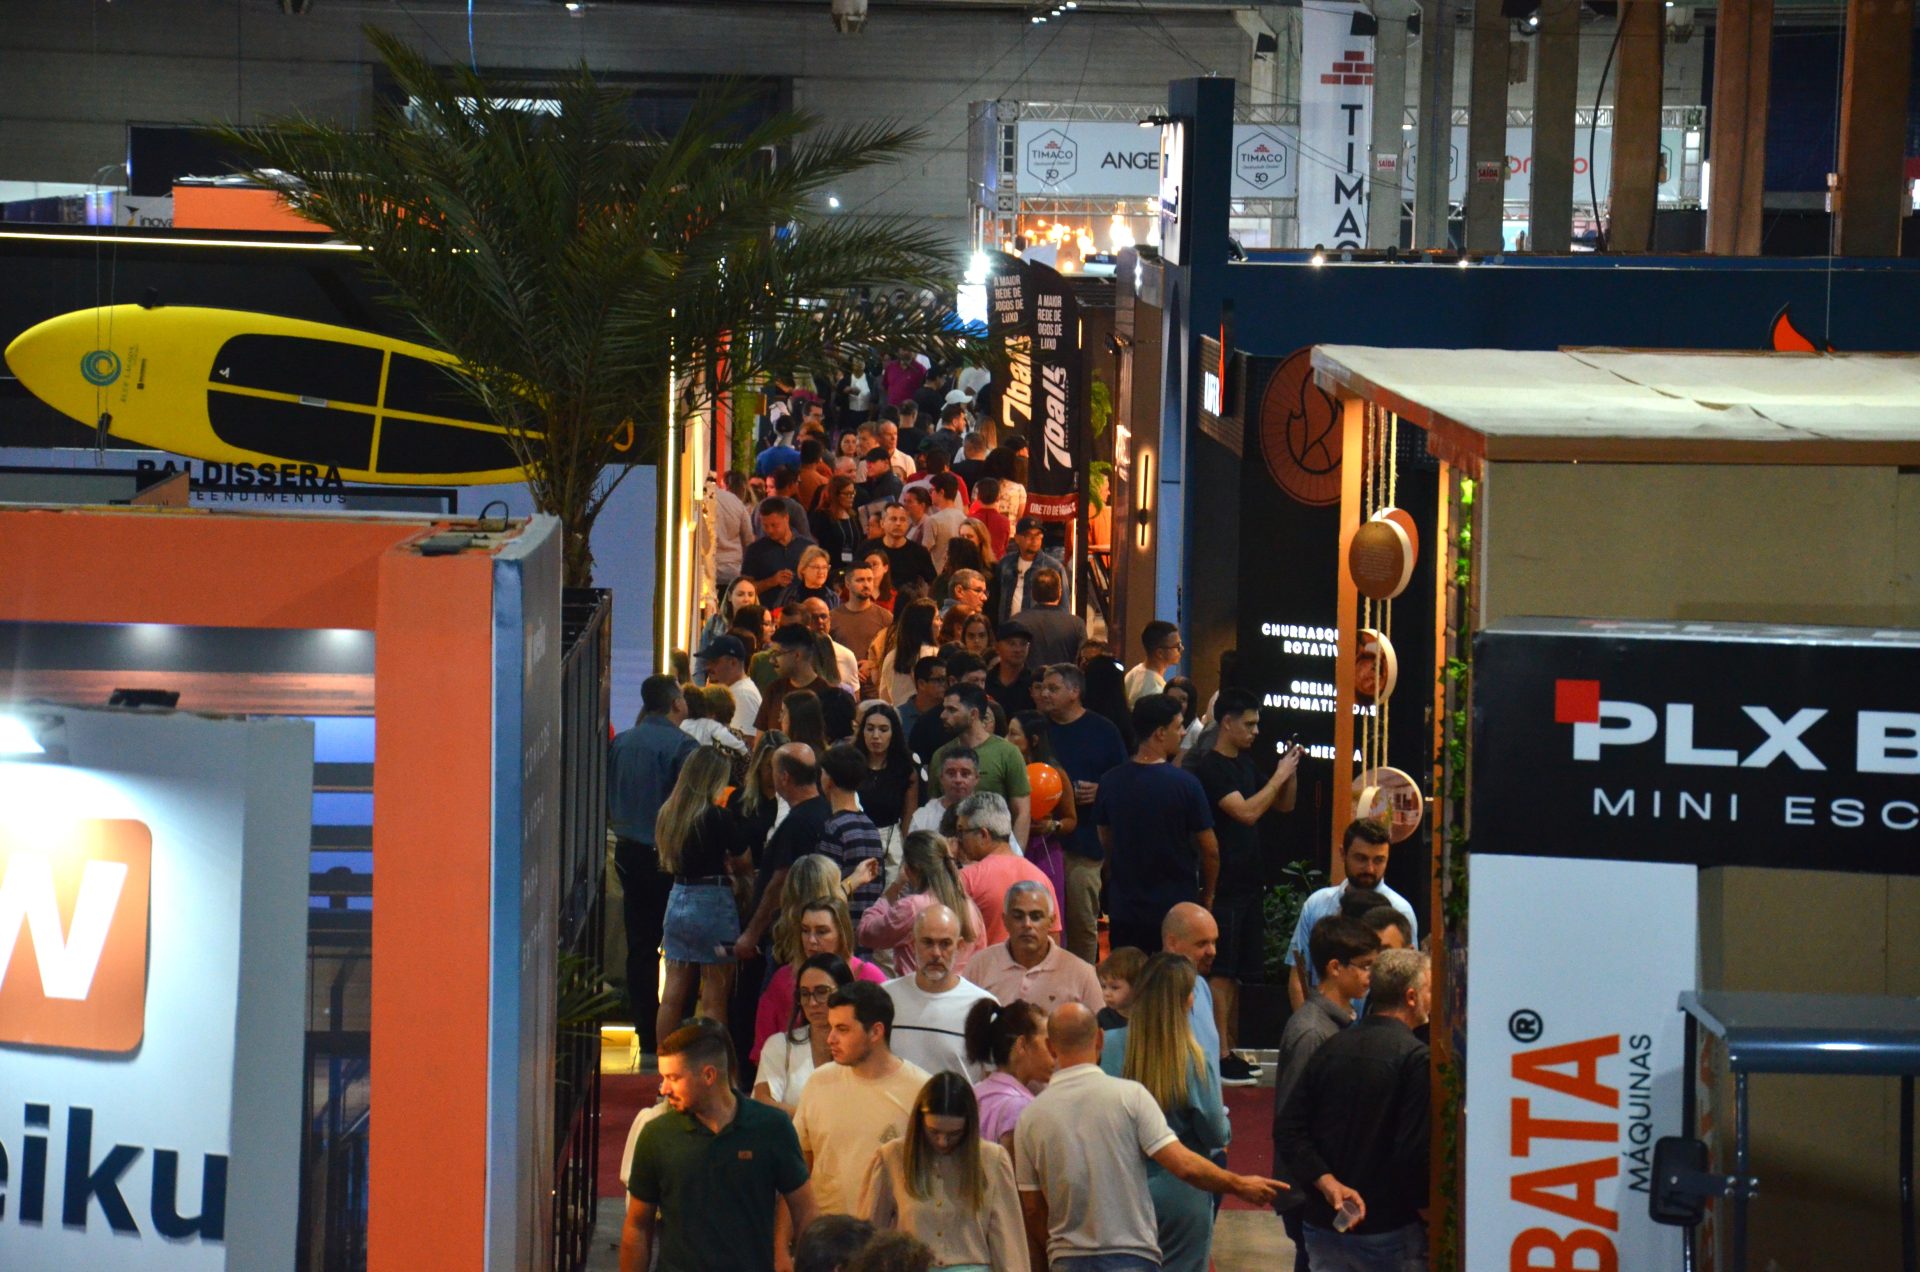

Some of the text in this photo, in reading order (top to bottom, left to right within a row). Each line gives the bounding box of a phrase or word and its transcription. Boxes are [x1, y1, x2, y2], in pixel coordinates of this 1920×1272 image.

[1031, 149, 1074, 160] TIMACO
[1100, 151, 1160, 170] ANGE
[1241, 153, 1283, 163] TIMACO
[1254, 172, 1269, 183] 50
[995, 286, 1022, 299] REDE DE
[1015, 298, 1024, 310] DE
[1037, 294, 1043, 307] A
[1037, 308, 1062, 322] REDE DE
[1054, 323, 1063, 336] DE
[1573, 700, 1828, 771] PLX
[1593, 788, 1738, 822] MINI
[1622, 1033, 1653, 1194] MÁQUINAS
